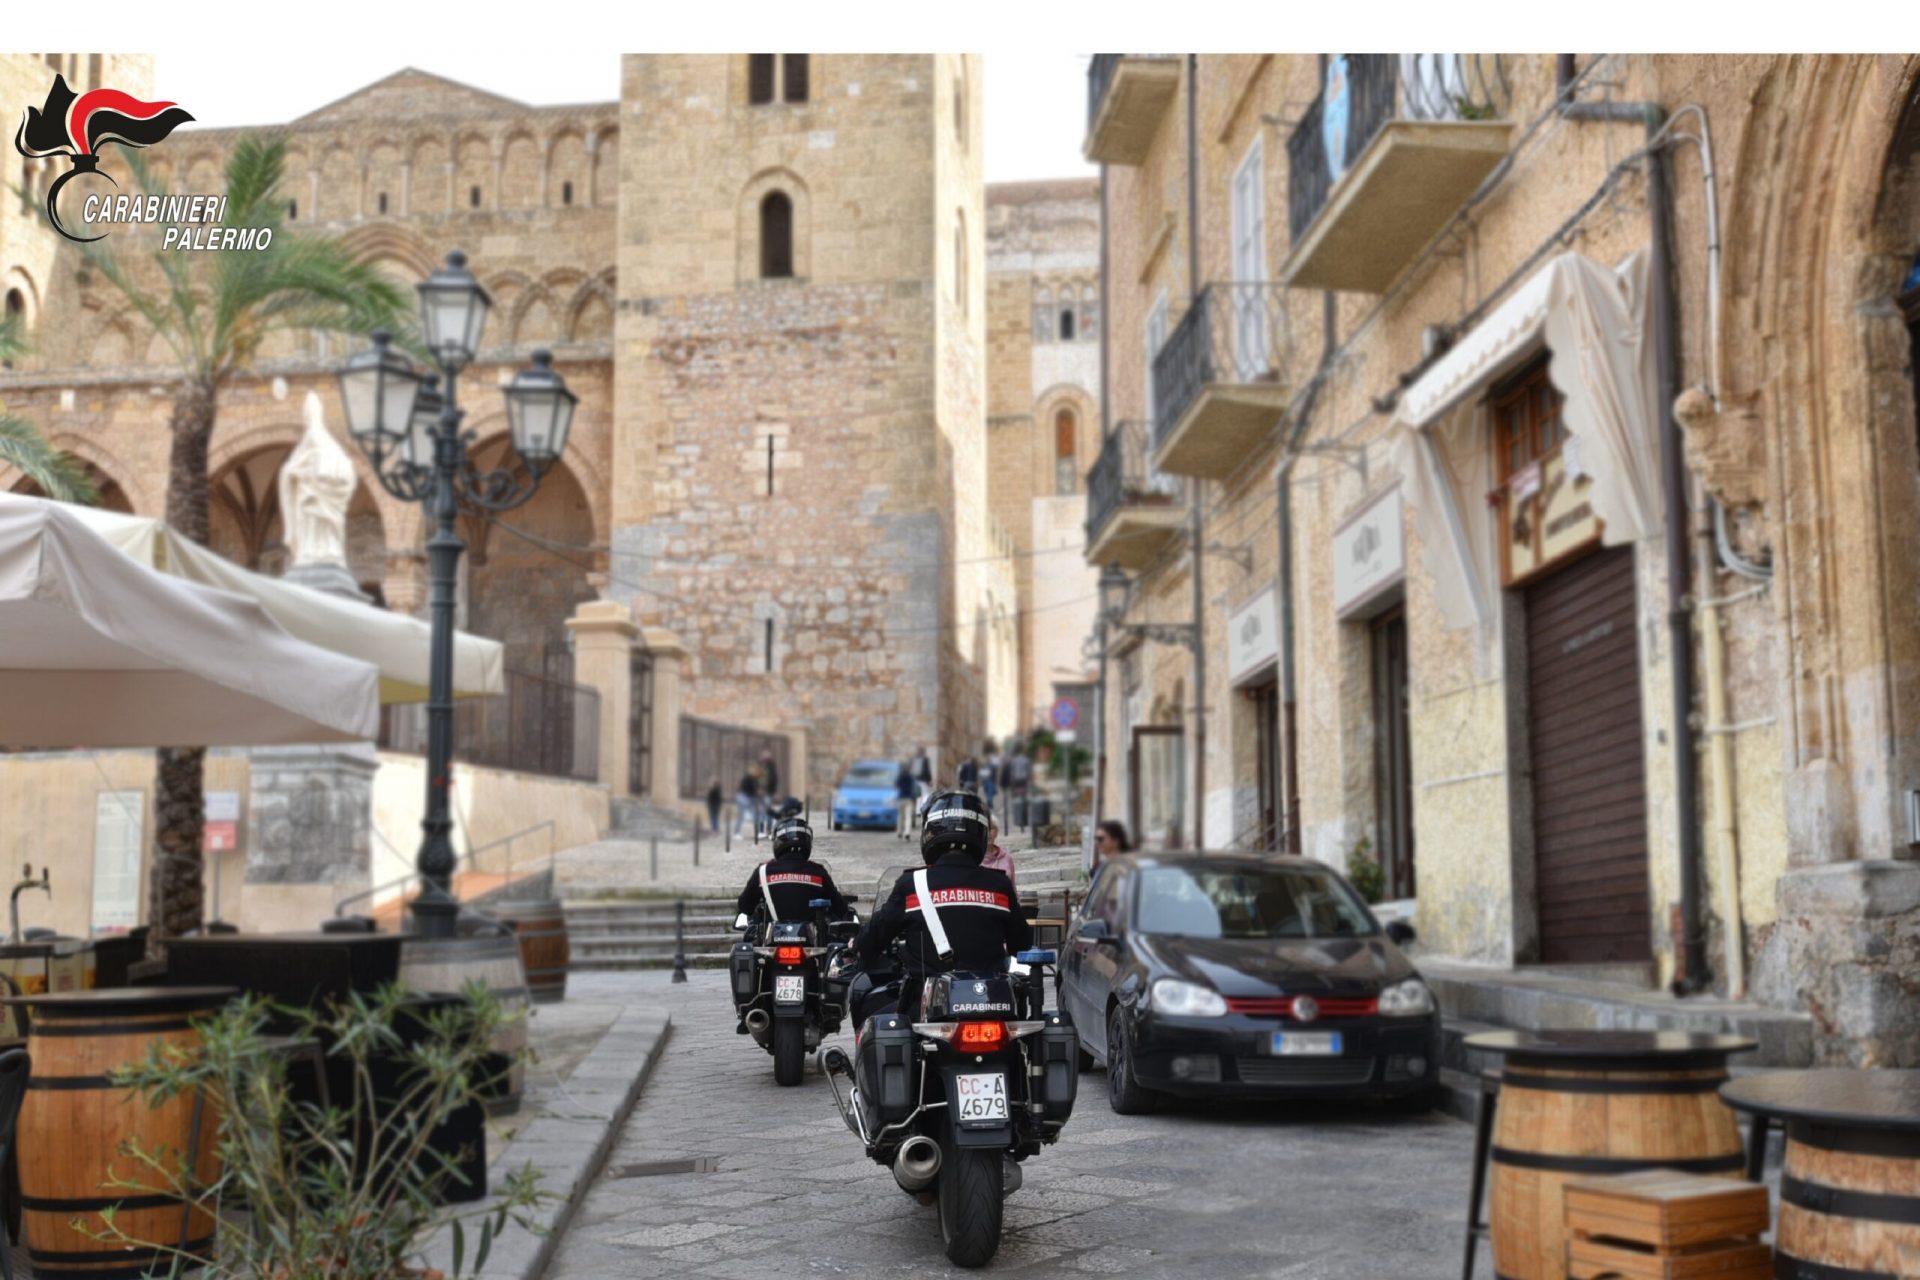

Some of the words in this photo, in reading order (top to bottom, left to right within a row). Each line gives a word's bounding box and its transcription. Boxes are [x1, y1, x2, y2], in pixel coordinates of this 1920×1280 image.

[769, 873, 812, 882] CARABINIERI
[929, 889, 995, 904] ARABINIERI
[777, 988, 802, 999] 4678
[952, 1003, 1011, 1012] CARABINIERI
[962, 1097, 1005, 1116] 4679
